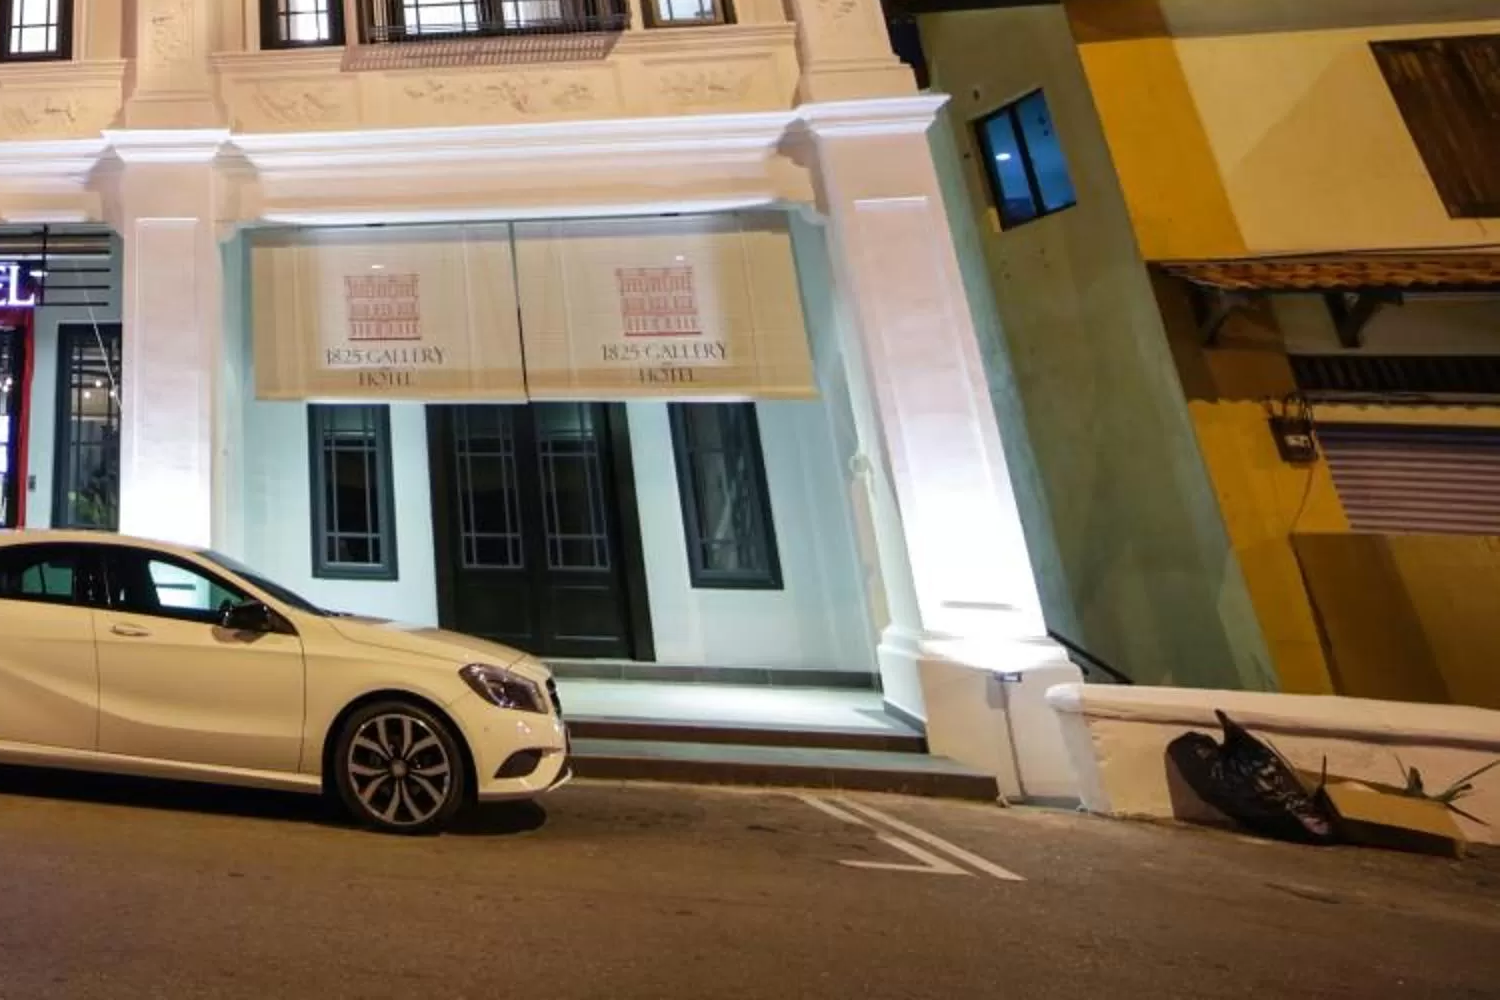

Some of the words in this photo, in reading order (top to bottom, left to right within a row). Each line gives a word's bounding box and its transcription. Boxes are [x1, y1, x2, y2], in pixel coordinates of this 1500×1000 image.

[326, 346, 362, 366] 1825
[365, 345, 445, 365] GALLERY
[601, 342, 640, 361] 1825
[643, 340, 728, 361] GALLERY
